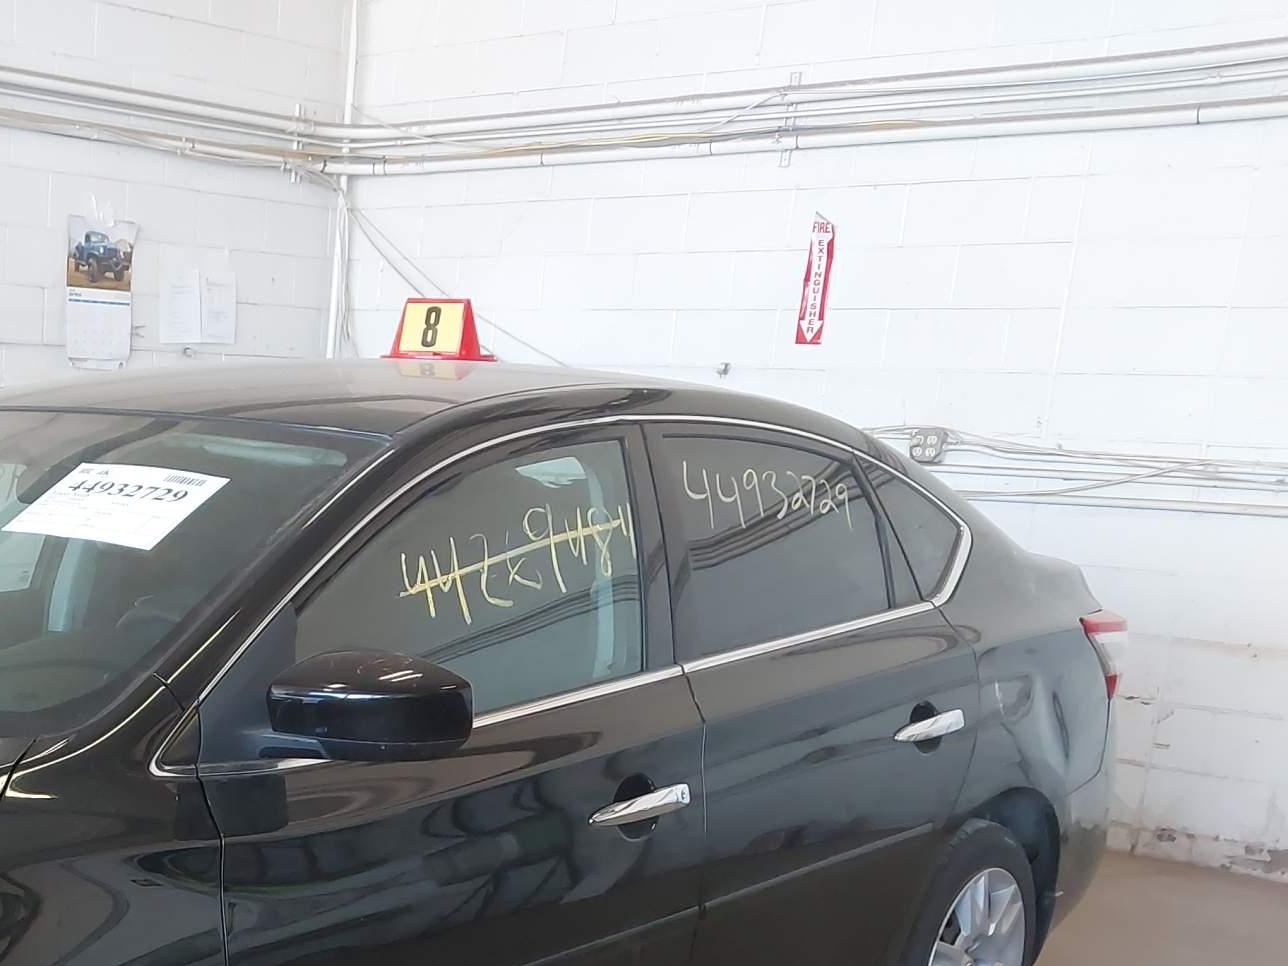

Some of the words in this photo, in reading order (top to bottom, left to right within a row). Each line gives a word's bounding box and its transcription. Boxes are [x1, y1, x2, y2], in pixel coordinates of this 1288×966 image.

[812, 222, 831, 234] FIRE
[806, 239, 825, 334] EXTINGUISHER
[421, 306, 442, 348] 8
[68, 479, 189, 503] 44932729
[682, 460, 853, 530] 44932729
